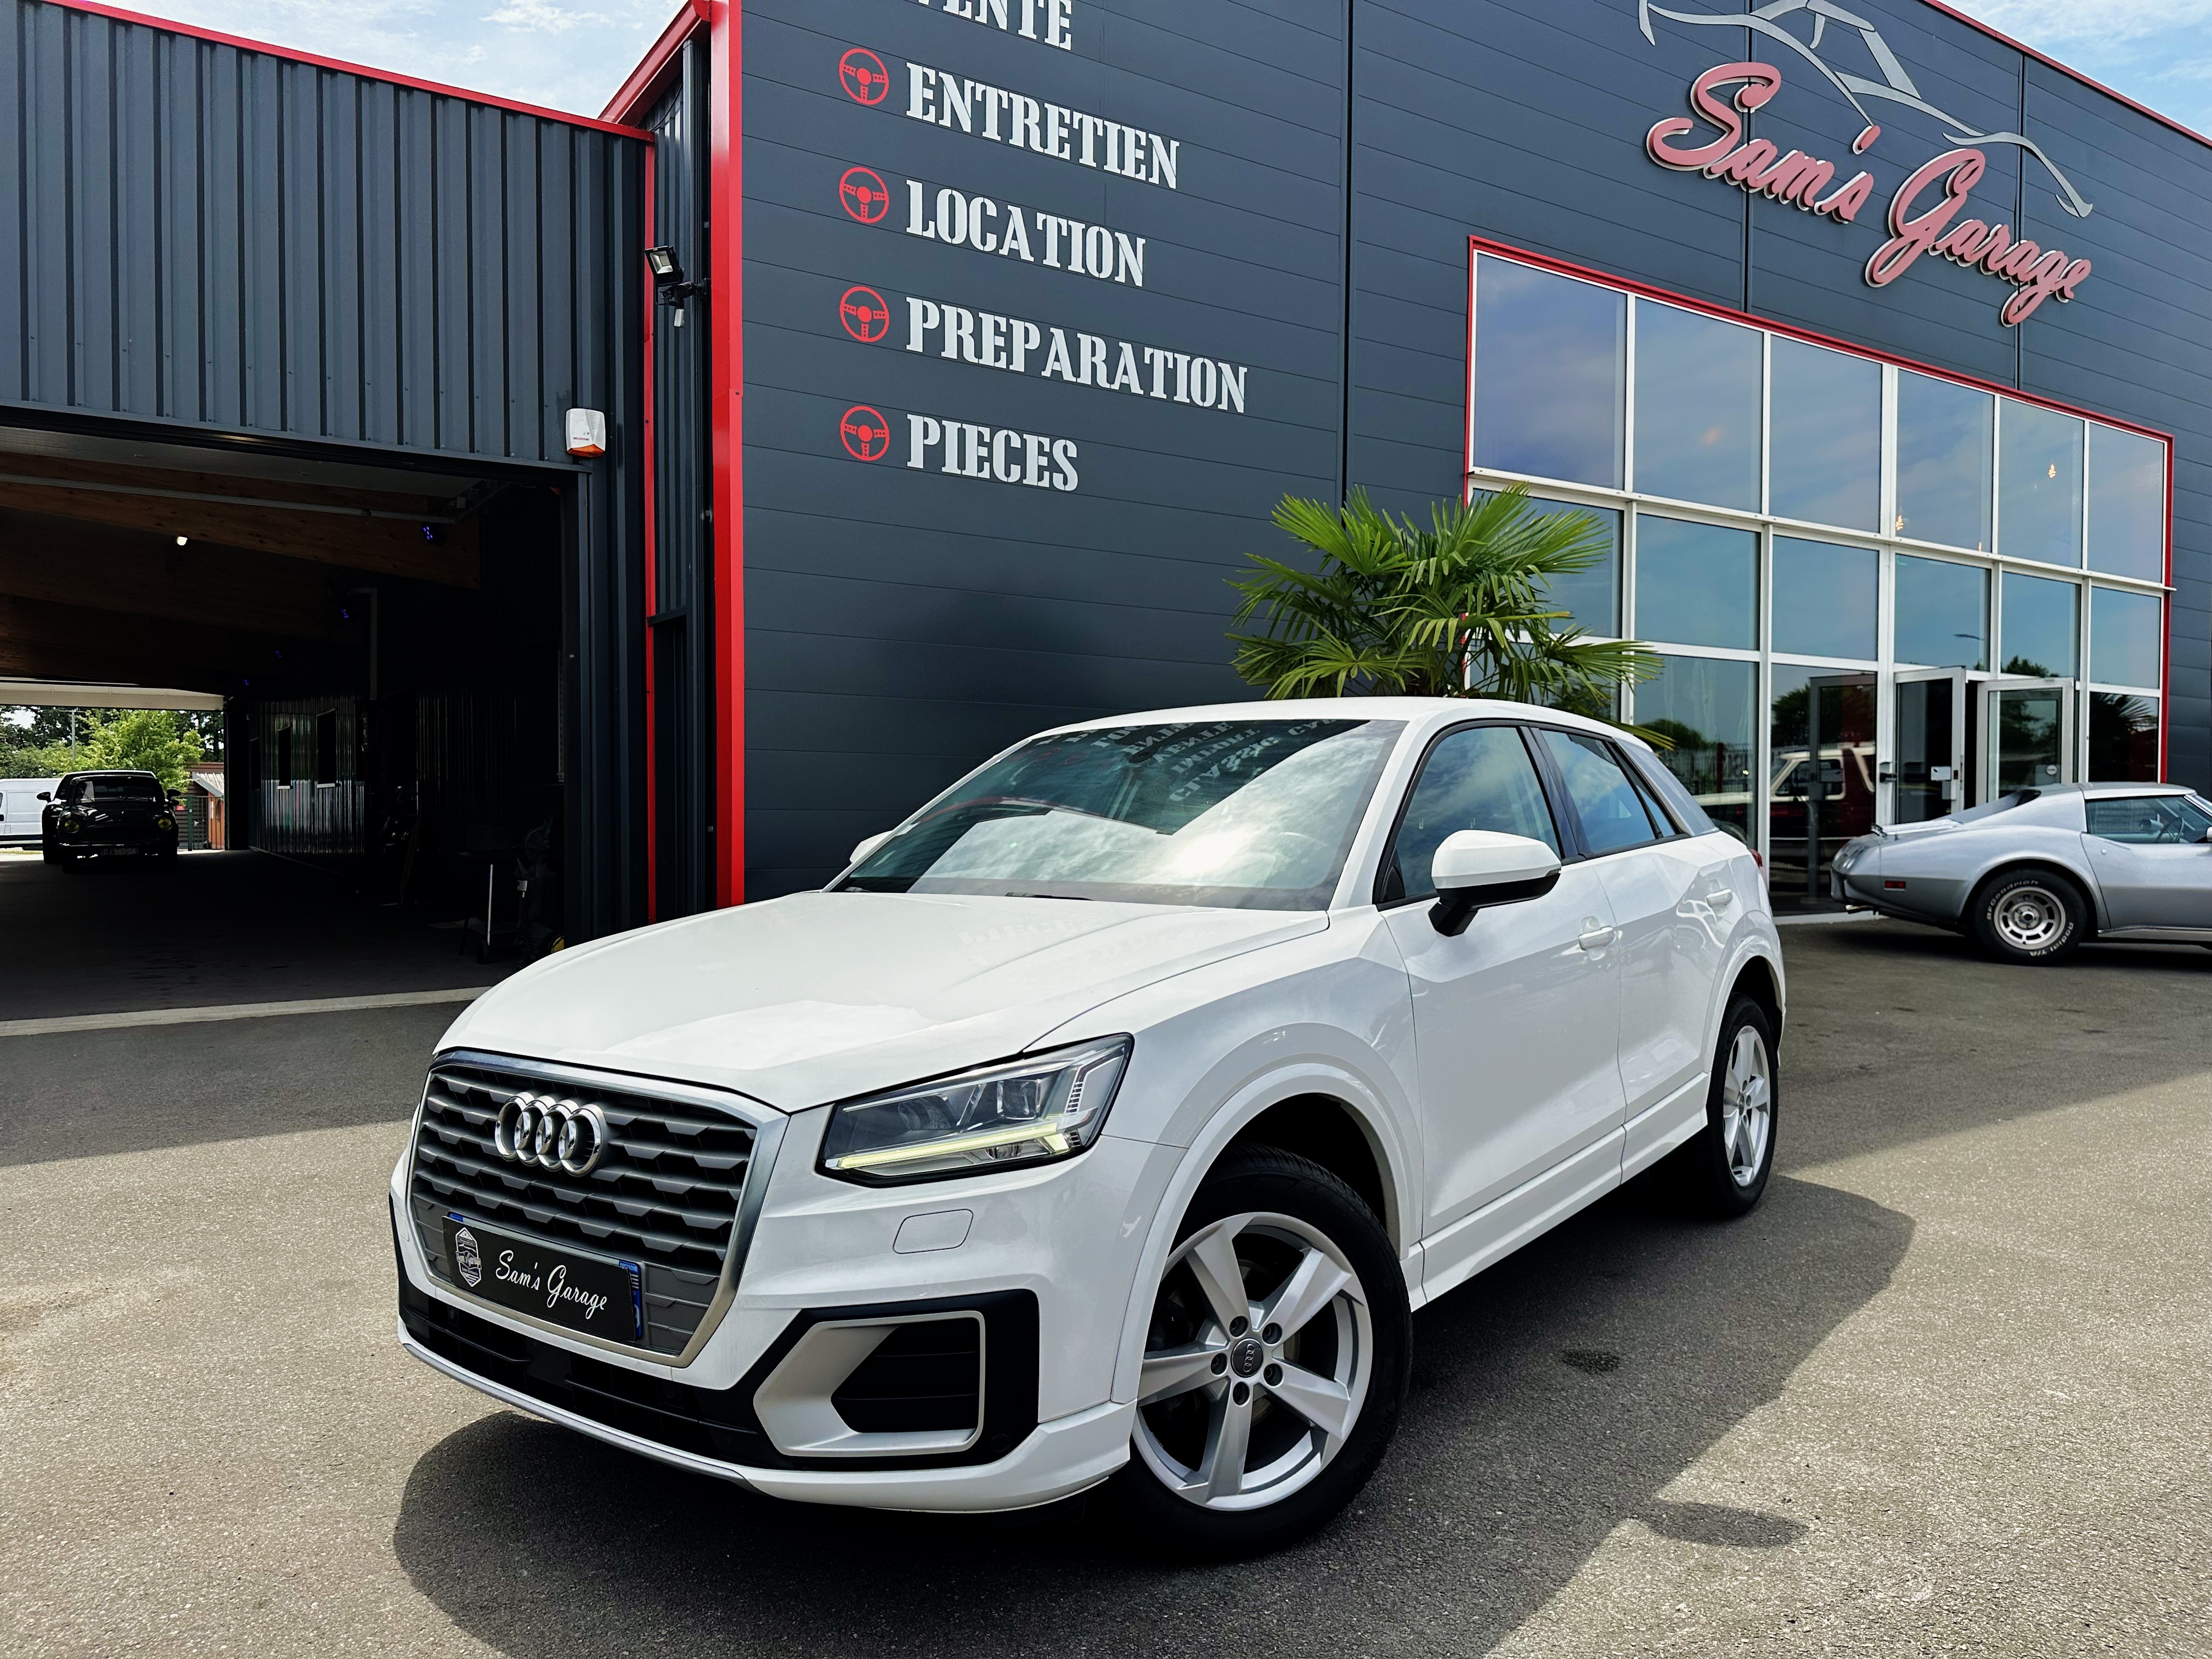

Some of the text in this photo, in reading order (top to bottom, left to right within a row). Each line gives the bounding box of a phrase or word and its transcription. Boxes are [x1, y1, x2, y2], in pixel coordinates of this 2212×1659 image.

[918, 0, 1071, 50] NTE
[906, 61, 1180, 189] ENTRETIEN
[906, 179, 1146, 287] LOCATION
[1646, 61, 2092, 328] Sam's Garage
[906, 296, 1248, 414] PREPARATION
[906, 414, 1079, 492] PIECES
[495, 1249, 607, 1319] Sam's Garage
